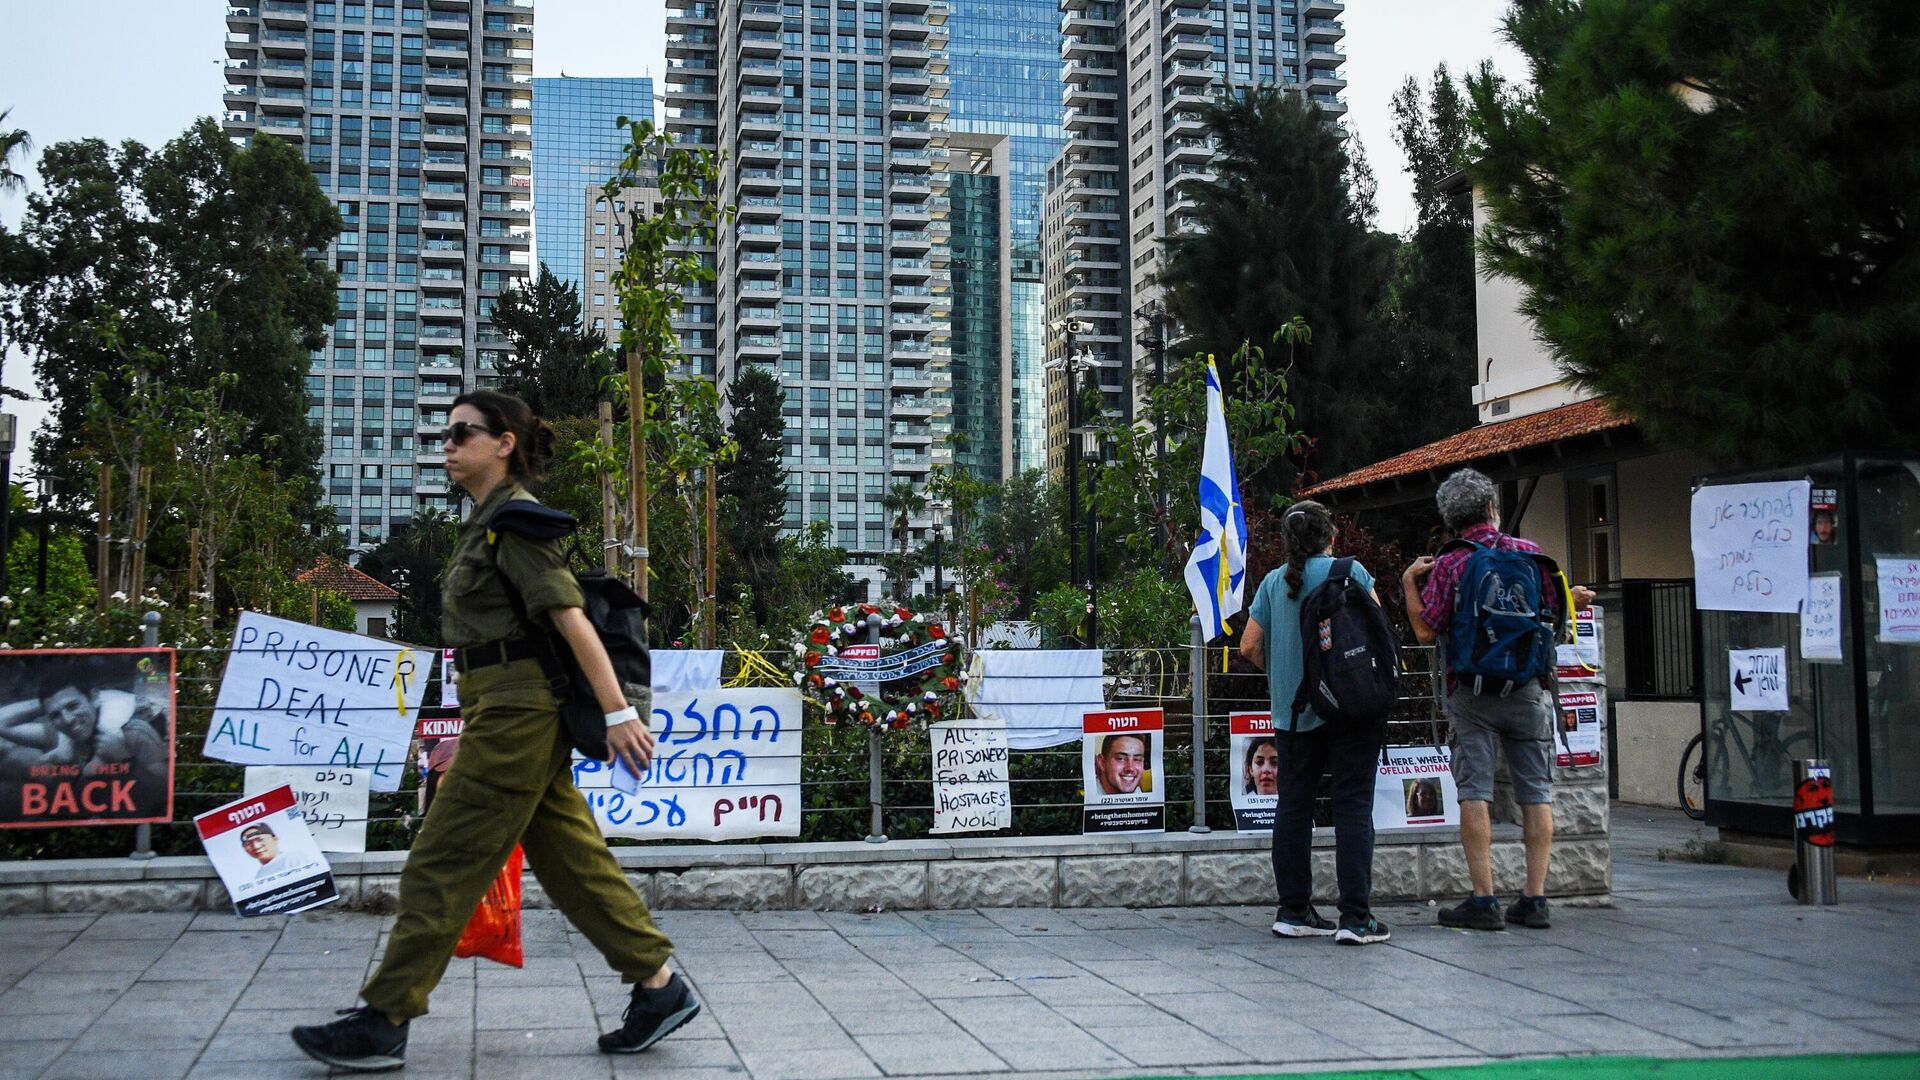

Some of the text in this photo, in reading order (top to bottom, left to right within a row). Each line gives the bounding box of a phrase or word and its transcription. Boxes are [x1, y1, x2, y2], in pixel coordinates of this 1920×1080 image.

[1709, 487, 1798, 529] להחזיר את
[1752, 519, 1792, 542] כולם
[1733, 570, 1773, 596] כולם
[239, 627, 415, 694] PRISONER
[840, 648, 878, 657] NAPPED
[257, 677, 349, 726] DEAL
[423, 720, 465, 736] KIDNA
[652, 699, 781, 746] החזר
[1107, 716, 1138, 730] חטוף
[1250, 719, 1274, 730] ופה
[212, 716, 388, 777] ALL for ALL
[944, 728, 972, 745] ALL
[937, 747, 1008, 768] PRISONERS
[1390, 757, 1416, 766] HERE.
[1417, 755, 1450, 765] WHERE
[30, 762, 131, 777] BRING THEM
[315, 769, 353, 786] כולם
[1380, 764, 1449, 775] OFELIA ROITMA
[22, 780, 137, 816] BACK
[940, 791, 1006, 813] HOSTAGES
[228, 801, 266, 825] חטוף
[714, 794, 782, 827] חיים
[952, 816, 996, 829] NOW
